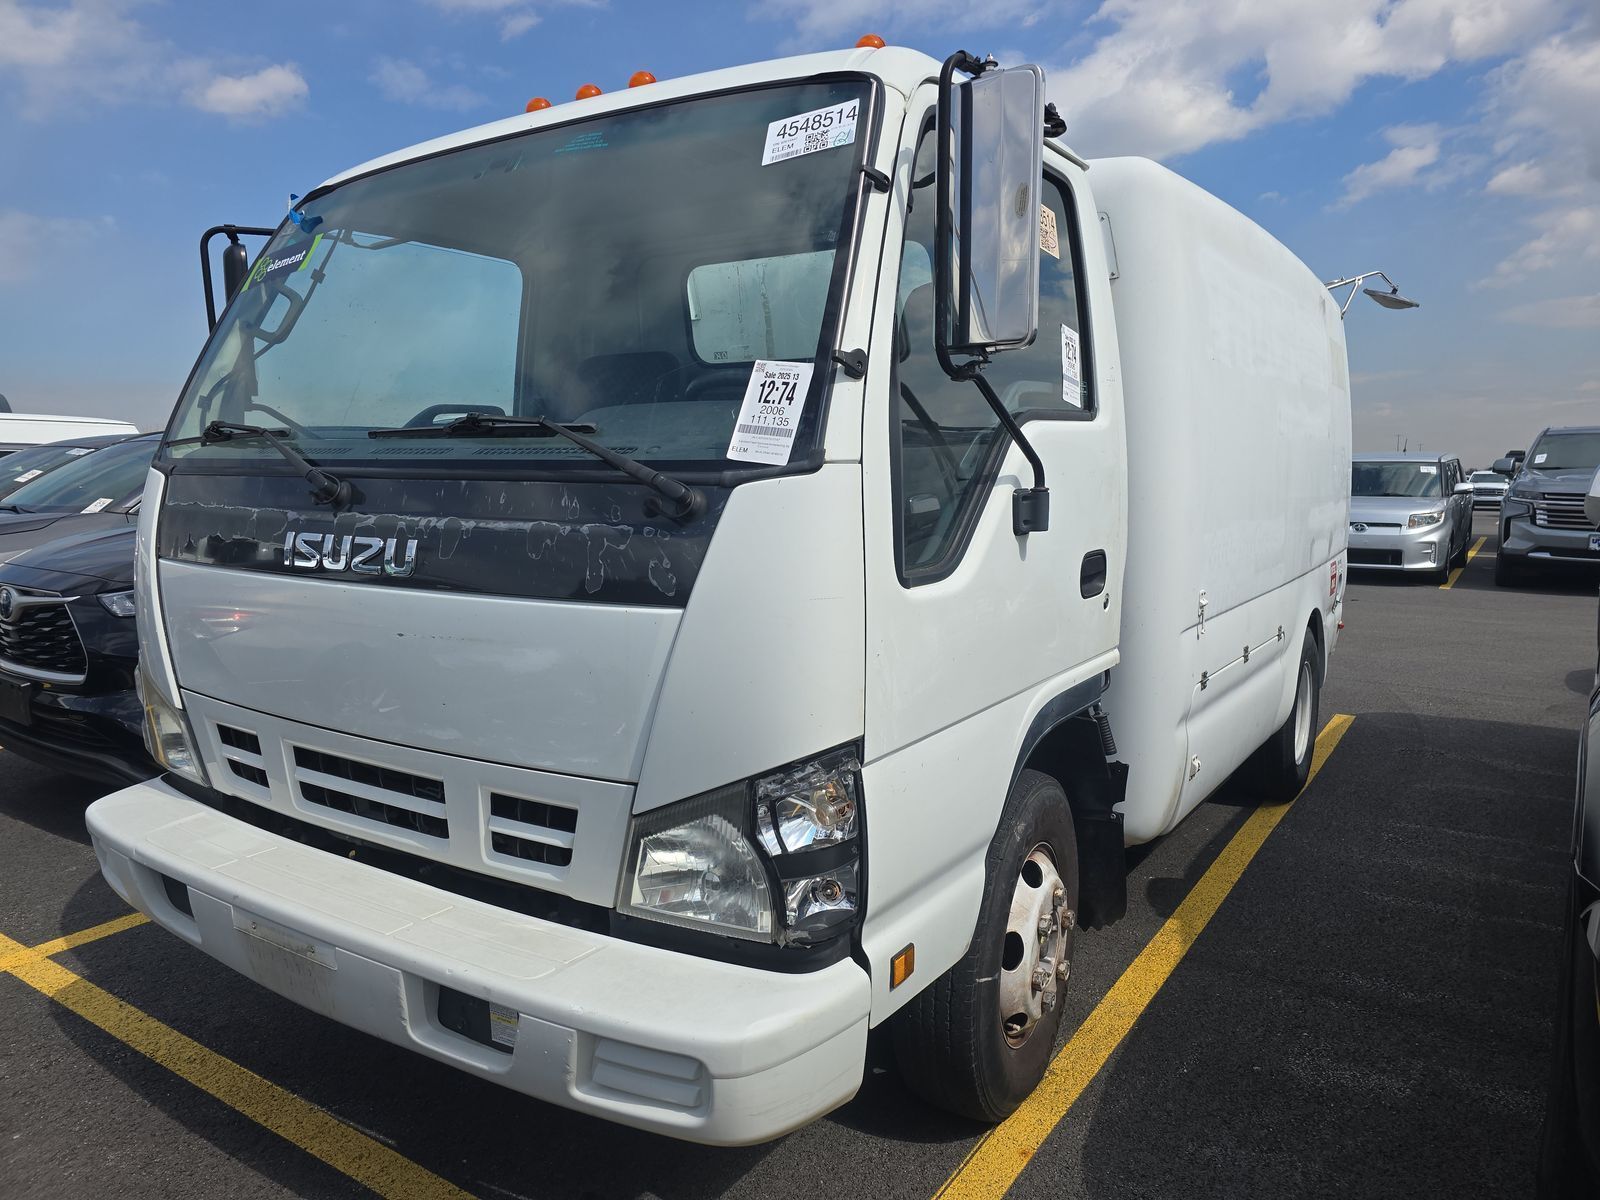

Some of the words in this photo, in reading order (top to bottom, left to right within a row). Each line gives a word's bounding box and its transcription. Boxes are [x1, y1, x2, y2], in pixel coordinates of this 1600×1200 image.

[776, 105, 857, 139] 4548514
[771, 143, 794, 154] ELEM
[267, 250, 306, 272] element
[764, 371, 776, 379] Sale
[777, 372, 791, 380] 2025
[757, 380, 798, 405] 12:74
[759, 405, 785, 415] 2006
[283, 531, 418, 577] ISUZU
